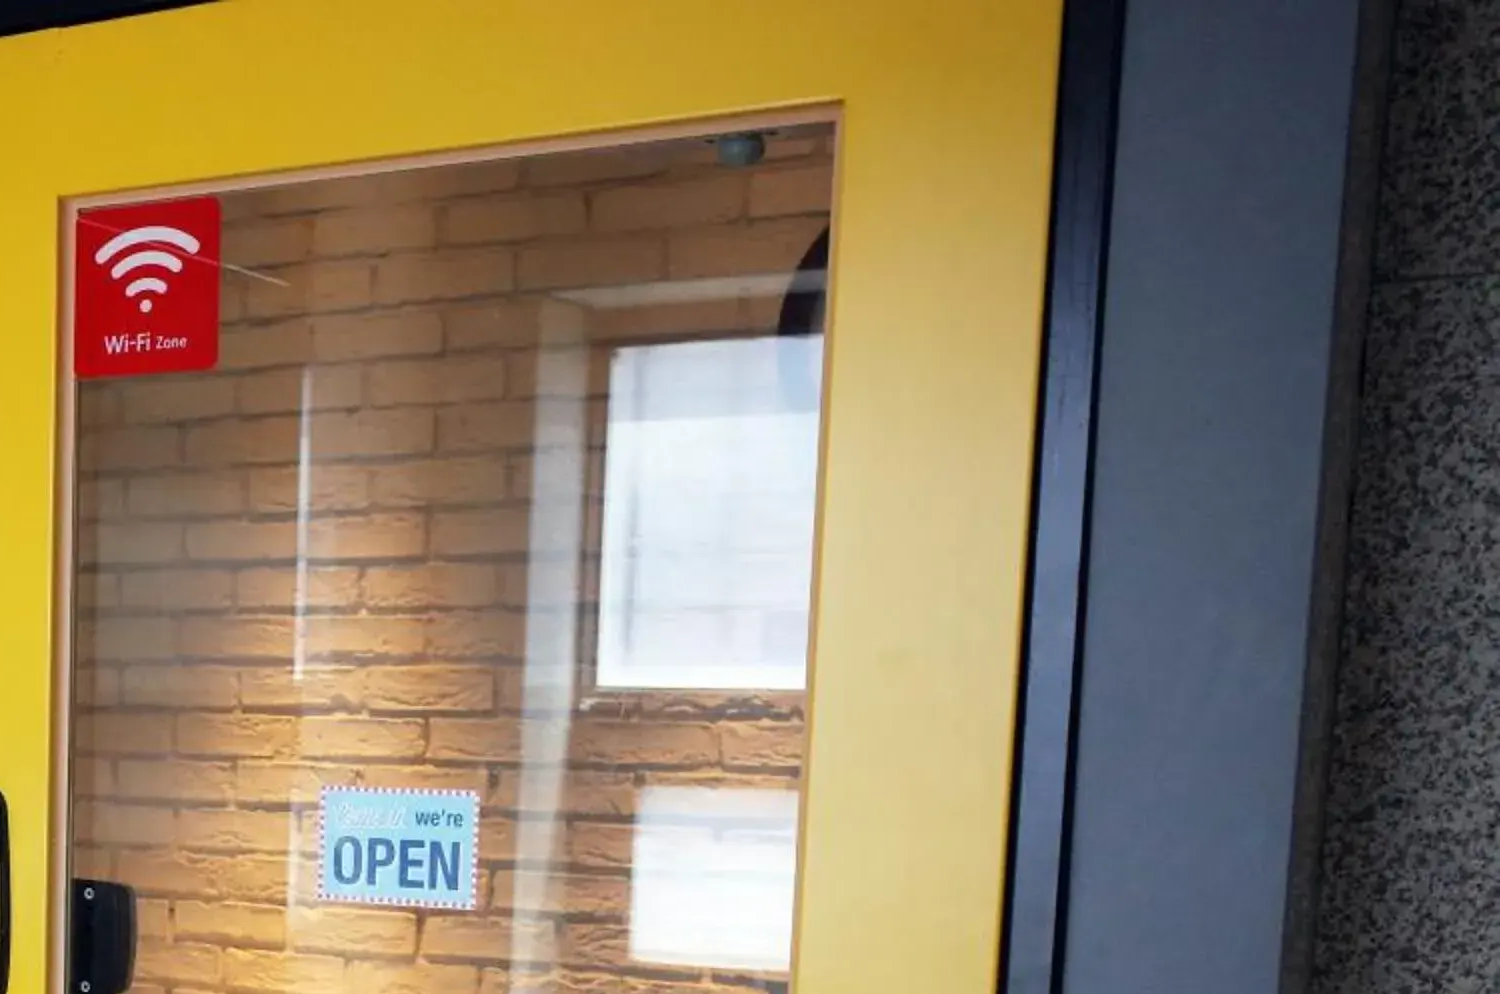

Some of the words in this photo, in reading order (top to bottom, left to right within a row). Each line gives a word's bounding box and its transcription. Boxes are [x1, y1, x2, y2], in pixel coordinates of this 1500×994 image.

[104, 331, 151, 355] Wi-Fi
[155, 335, 188, 350] Zone
[415, 808, 464, 828] we're
[333, 836, 461, 891] OPEN
